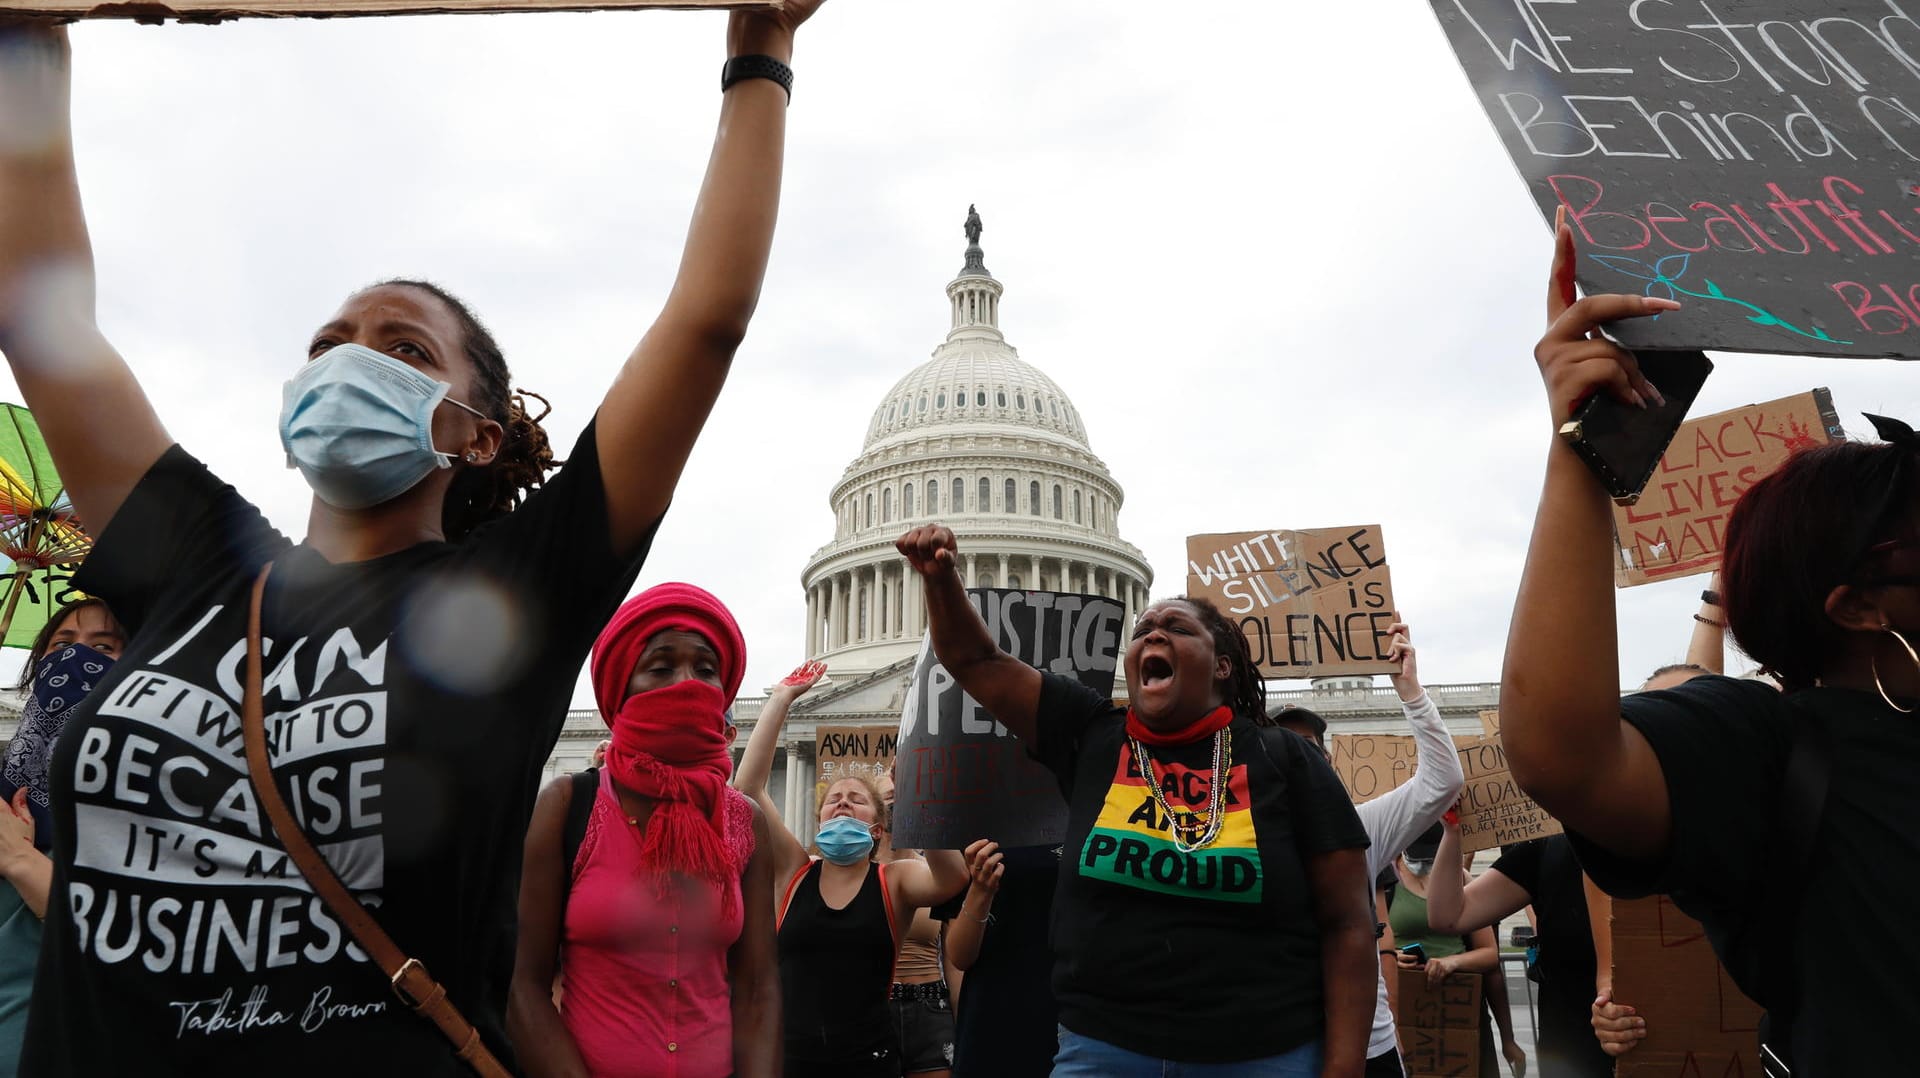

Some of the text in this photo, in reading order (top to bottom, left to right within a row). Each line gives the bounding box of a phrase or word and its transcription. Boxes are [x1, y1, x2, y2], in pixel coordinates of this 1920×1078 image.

[1453, 0, 1634, 74] WE
[1660, 413, 1786, 473] LACK
[1190, 533, 1294, 587] WHITE
[1634, 513, 1732, 568] MAT
[1223, 529, 1386, 614] SILENCE
[1347, 581, 1385, 608] is
[149, 604, 389, 702] I CAN
[967, 591, 1124, 673] USTICE
[1240, 612, 1393, 667] OLENCE
[115, 674, 169, 708] IF
[161, 688, 188, 721] I
[315, 699, 373, 745] TO
[820, 733, 868, 757] ASIAN
[1335, 738, 1375, 761] NO
[1126, 752, 1241, 806] BACK
[1336, 764, 1377, 800] NO
[1461, 821, 1498, 837] BLACK
[1503, 815, 1537, 828] TRANS
[1474, 805, 1498, 820] SAY
[1500, 803, 1522, 817] HIS
[1495, 823, 1545, 845] MATTER
[124, 822, 218, 880] IT'S
[1085, 833, 1258, 894] PROUD
[169, 984, 386, 1040] Tabitha Brown
